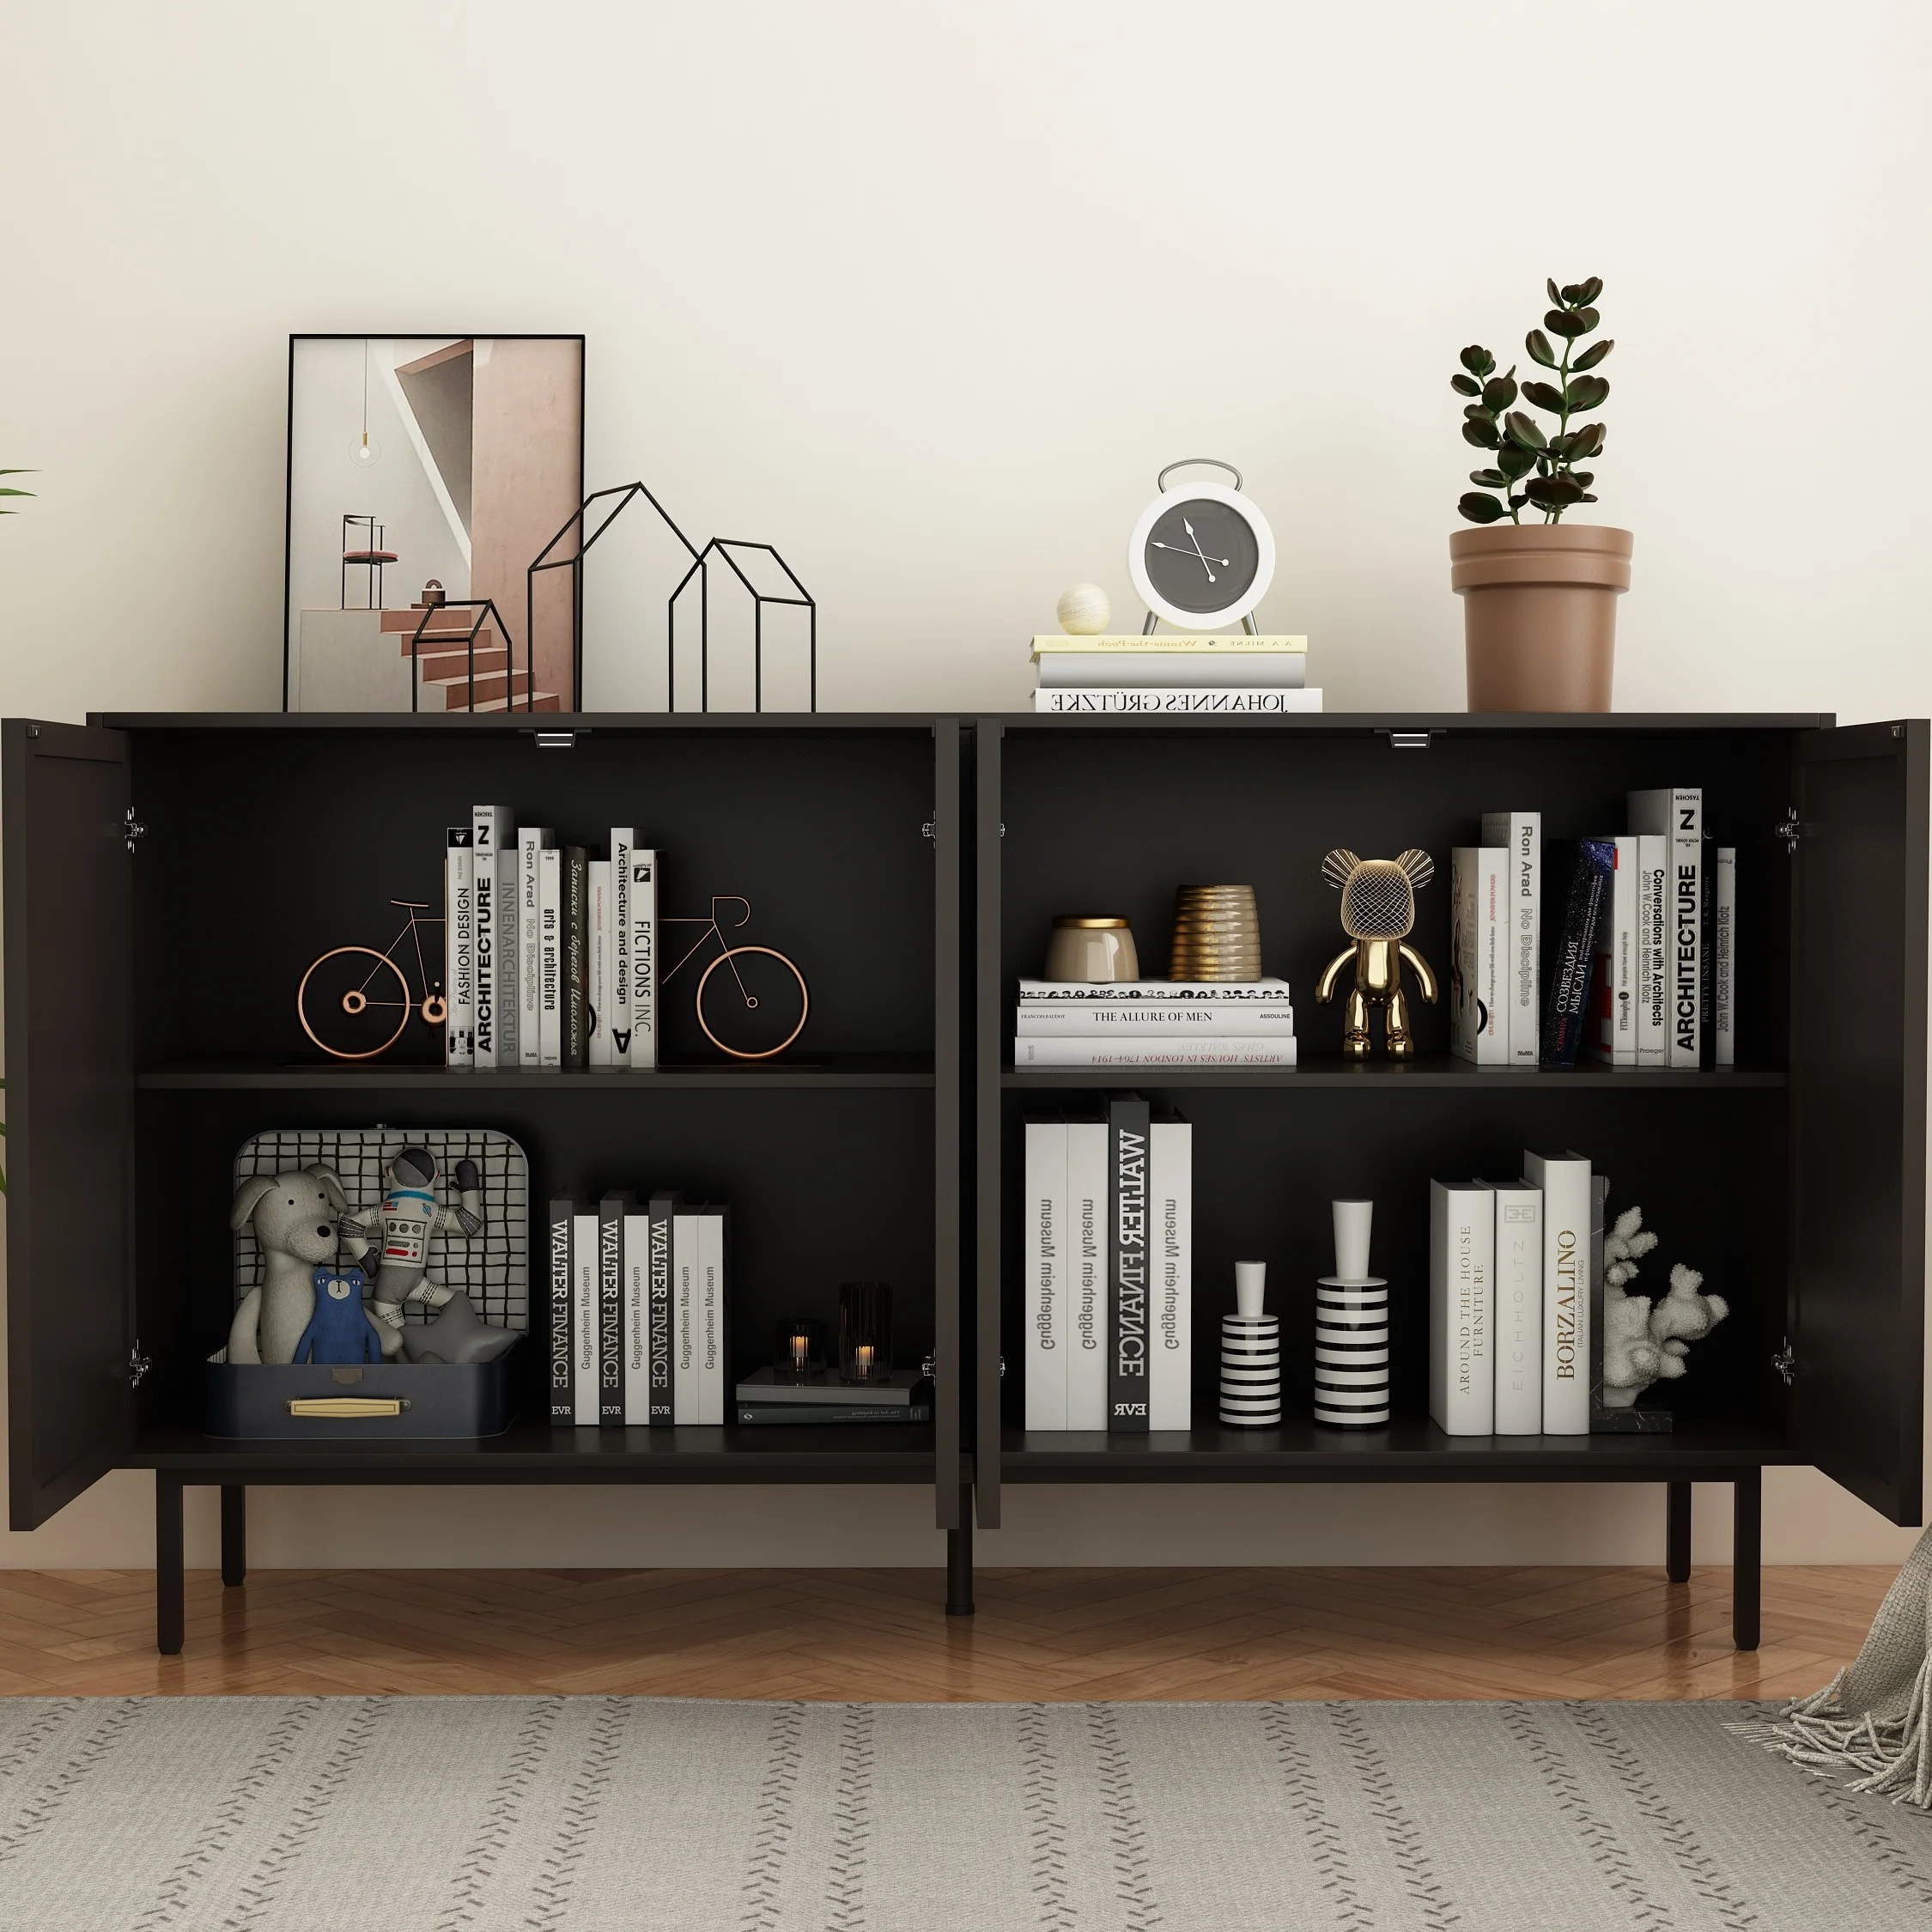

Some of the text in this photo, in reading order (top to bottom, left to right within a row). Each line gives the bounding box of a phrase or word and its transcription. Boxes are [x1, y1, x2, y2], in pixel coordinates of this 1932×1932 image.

[571, 860, 581, 915] Записки
[1522, 827, 1533, 896] Ron Arad
[1643, 871, 1652, 890] John
[458, 889, 470, 1004] FASHION DESIGN
[544, 909, 556, 928] arts
[617, 843, 628, 1004] Architecture and design
[1643, 928, 1651, 945] and
[1652, 870, 1664, 1027] Conversations with Architects
[1718, 907, 1728, 928] Klotz
[1718, 929, 1728, 959] Heinrich
[477, 878, 491, 1053] ARCHITECTURE
[502, 883, 514, 1054] INNENARCHITEKTUR
[526, 919, 537, 1012] No Discipline
[544, 947, 556, 1010] architecture
[568, 935, 580, 983] берегов
[635, 921, 651, 1036] FICTIONS INC.
[1520, 909, 1533, 1007] No Discipline
[1556, 941, 1579, 1013] СОЗВЕЗДИЯ
[1568, 963, 1588, 1014] МЫСЛИ
[1643, 948, 1651, 981] Heinrich
[1677, 866, 1695, 1051] ARCHITECTURE
[1718, 961, 1728, 975] and
[1093, 1012, 1212, 1021] THE ALLURE OF MEN
[1642, 985, 1651, 1003] Klotz
[1717, 1012, 1728, 1033] John
[612, 1029, 631, 1054] A
[1144, 1055, 1188, 1064] LONDON
[1188, 1054, 1199, 1063] IN
[1201, 1054, 1238, 1063] HOUSES
[552, 1219, 568, 1388] WALTER FINANCE
[581, 1267, 592, 1370] Guggenheim Museum
[603, 1219, 618, 1388] WALTER FINANCE
[652, 1219, 667, 1388] WALTER FINANCE
[705, 1267, 716, 1369] Guggenheim Museum
[1460, 1227, 1470, 1394] AROUND THE HOUSE
[1473, 1266, 1483, 1356] FURNITURE
[1513, 1241, 1524, 1390] EICHHOLTZ
[1557, 1230, 1576, 1380] BORZALINO
[632, 1310, 642, 1369] Guggenheim
[681, 1310, 691, 1369] Guggenheim
